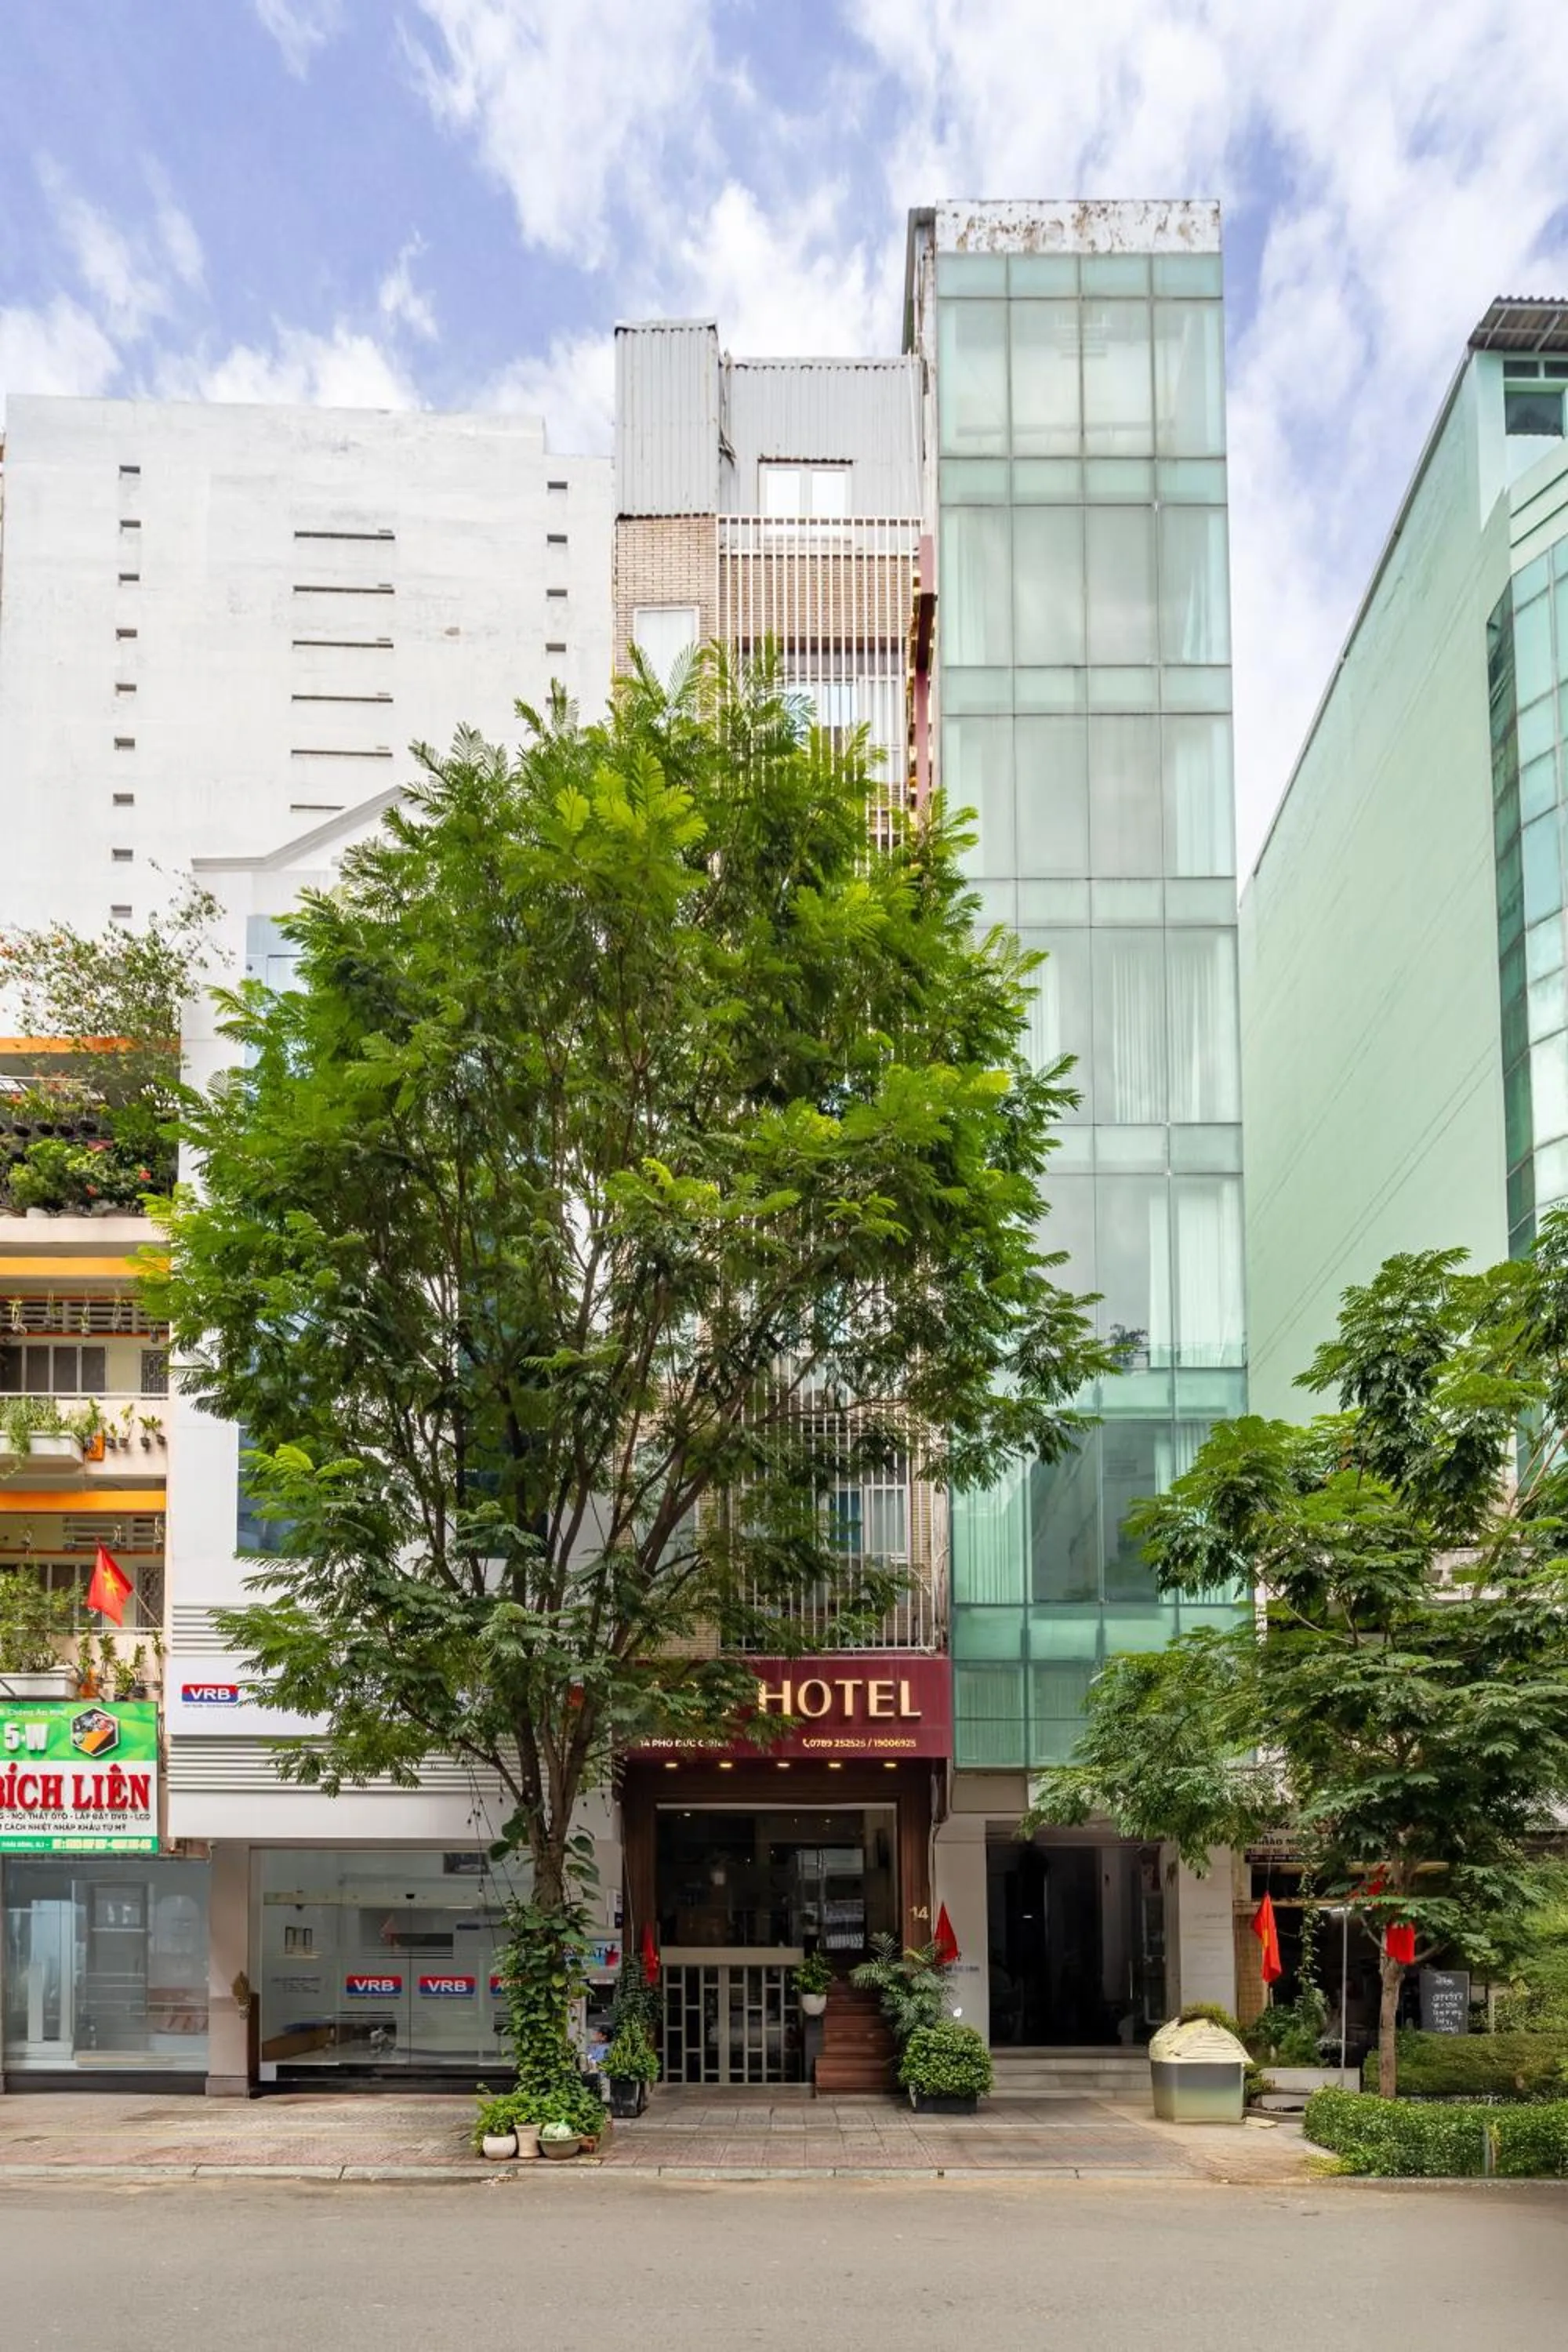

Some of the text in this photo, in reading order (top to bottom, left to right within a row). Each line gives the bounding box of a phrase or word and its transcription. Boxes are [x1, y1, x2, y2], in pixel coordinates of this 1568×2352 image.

[190, 1687, 230, 1700] VRB
[758, 1679, 923, 1717] HOTEL
[0, 1762, 151, 1810] ÍCH LIÊN
[910, 1906, 928, 1920] 14
[354, 1980, 394, 1992] VRB
[427, 1980, 467, 1992] VRB
